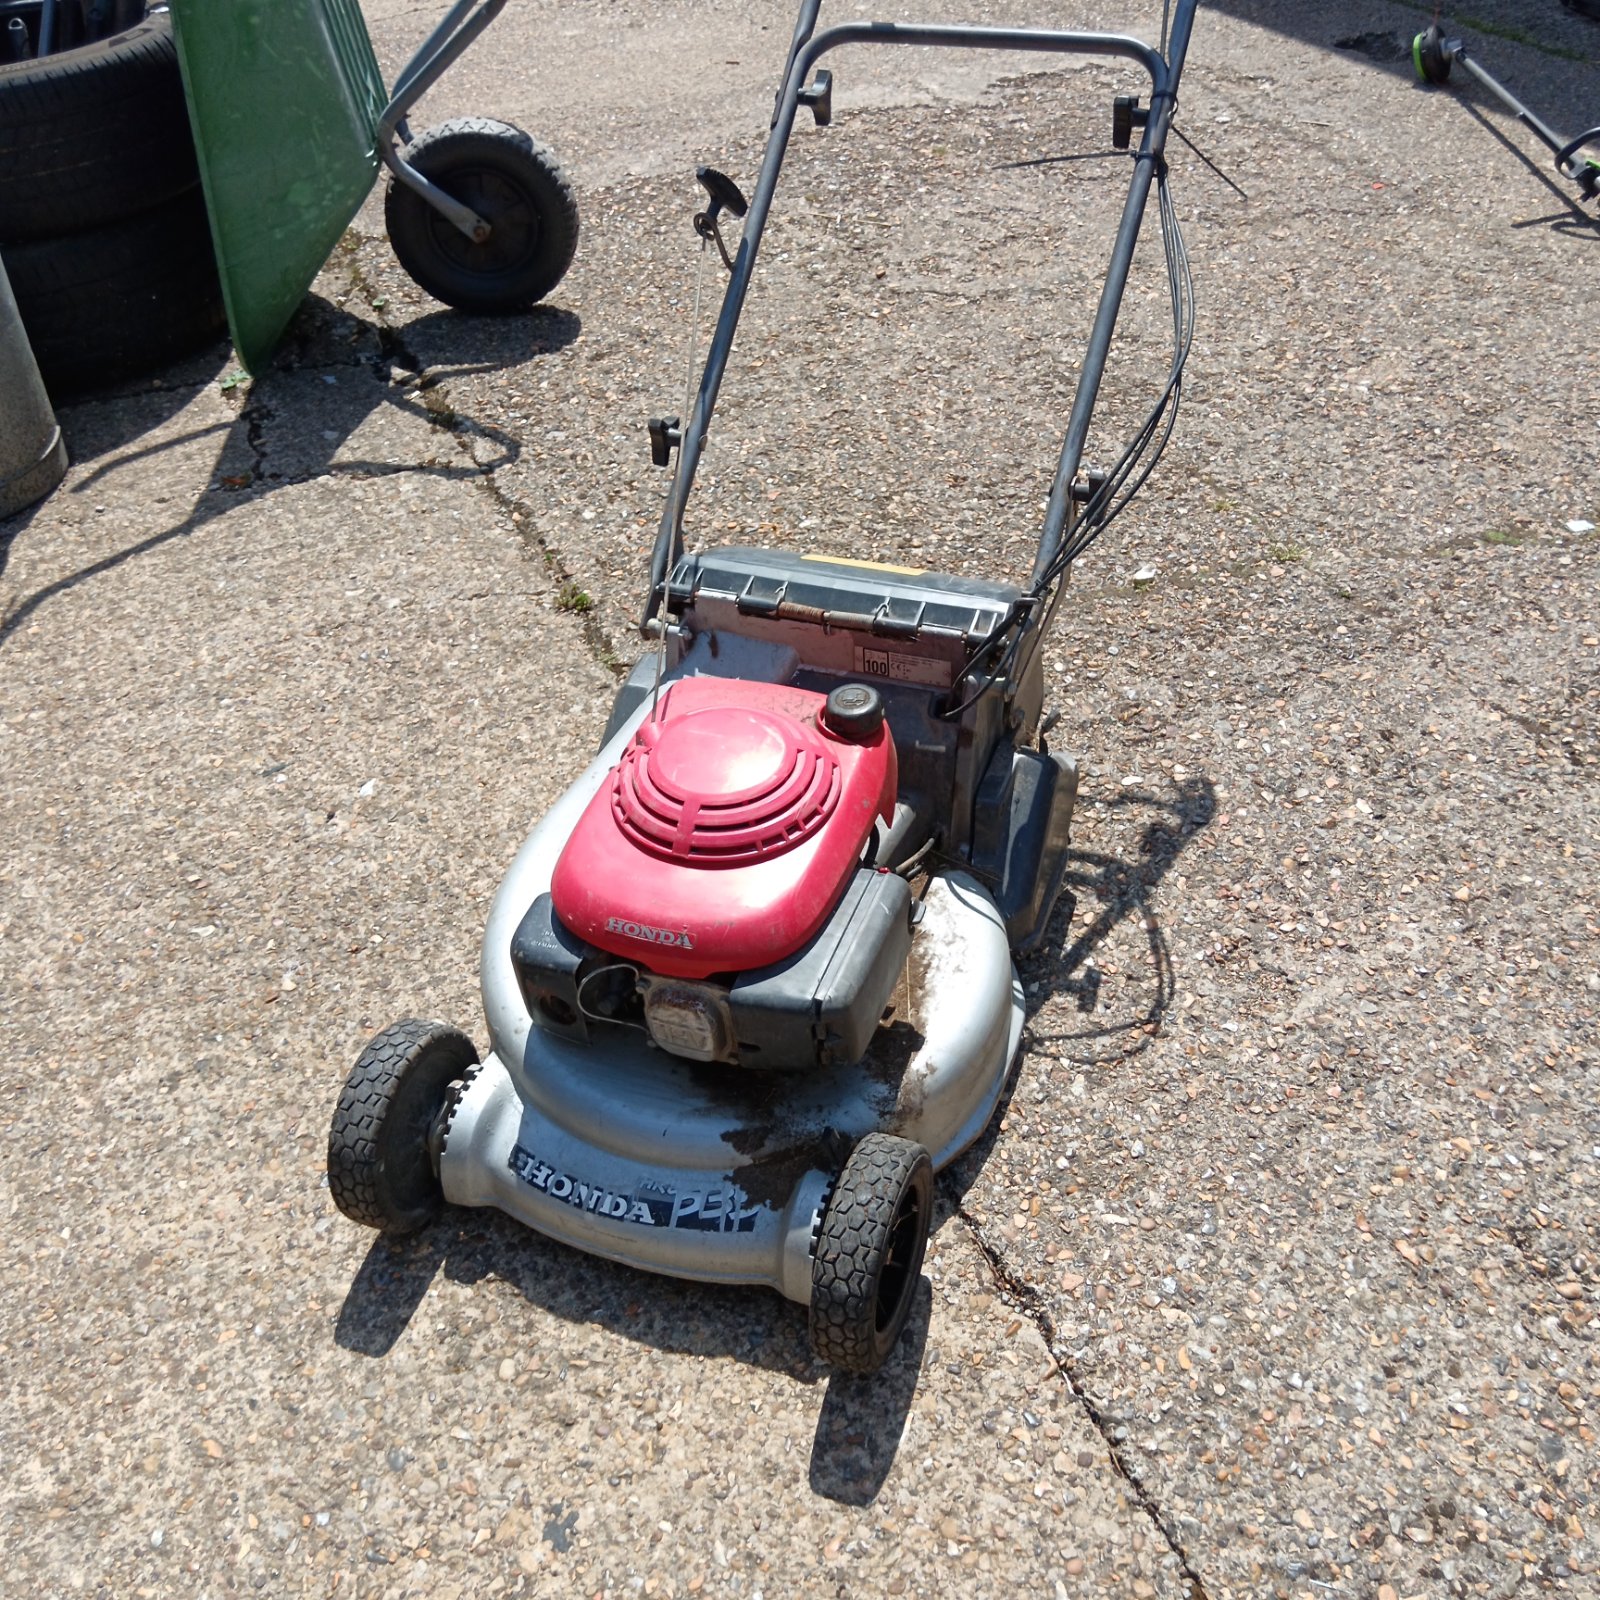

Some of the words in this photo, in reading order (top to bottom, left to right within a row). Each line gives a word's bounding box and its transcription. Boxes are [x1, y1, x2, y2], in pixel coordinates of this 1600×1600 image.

[865, 660, 887, 674] 100
[608, 918, 693, 949] HONDA
[519, 1155, 656, 1225] HONDA
